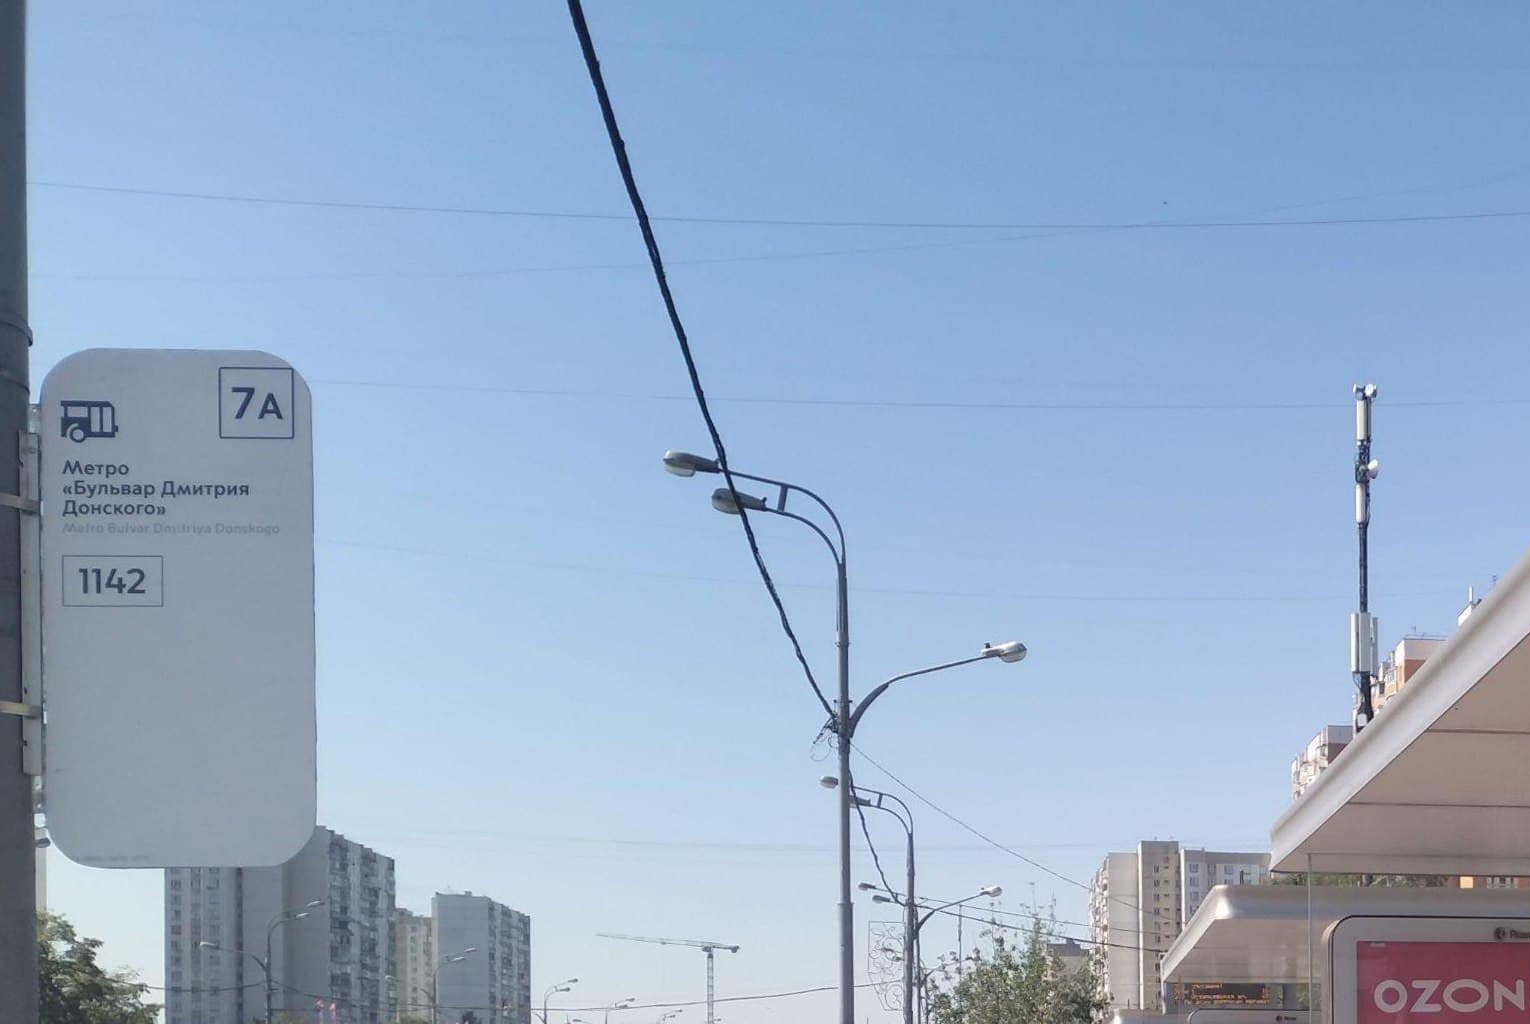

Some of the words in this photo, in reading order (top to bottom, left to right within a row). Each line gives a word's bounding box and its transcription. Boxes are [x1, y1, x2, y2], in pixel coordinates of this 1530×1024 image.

[61, 460, 129, 478] Метро
[62, 480, 156, 499] «Бульвар
[160, 480, 250, 499] Дмитрия
[61, 500, 167, 517] Донского»
[62, 523, 104, 534] Metro
[108, 523, 149, 534] Bulvar
[153, 523, 212, 536] Dmitriya
[215, 522, 280, 536] Donskogo
[78, 567, 147, 595] 1142
[1374, 978, 1525, 1014] OZON
